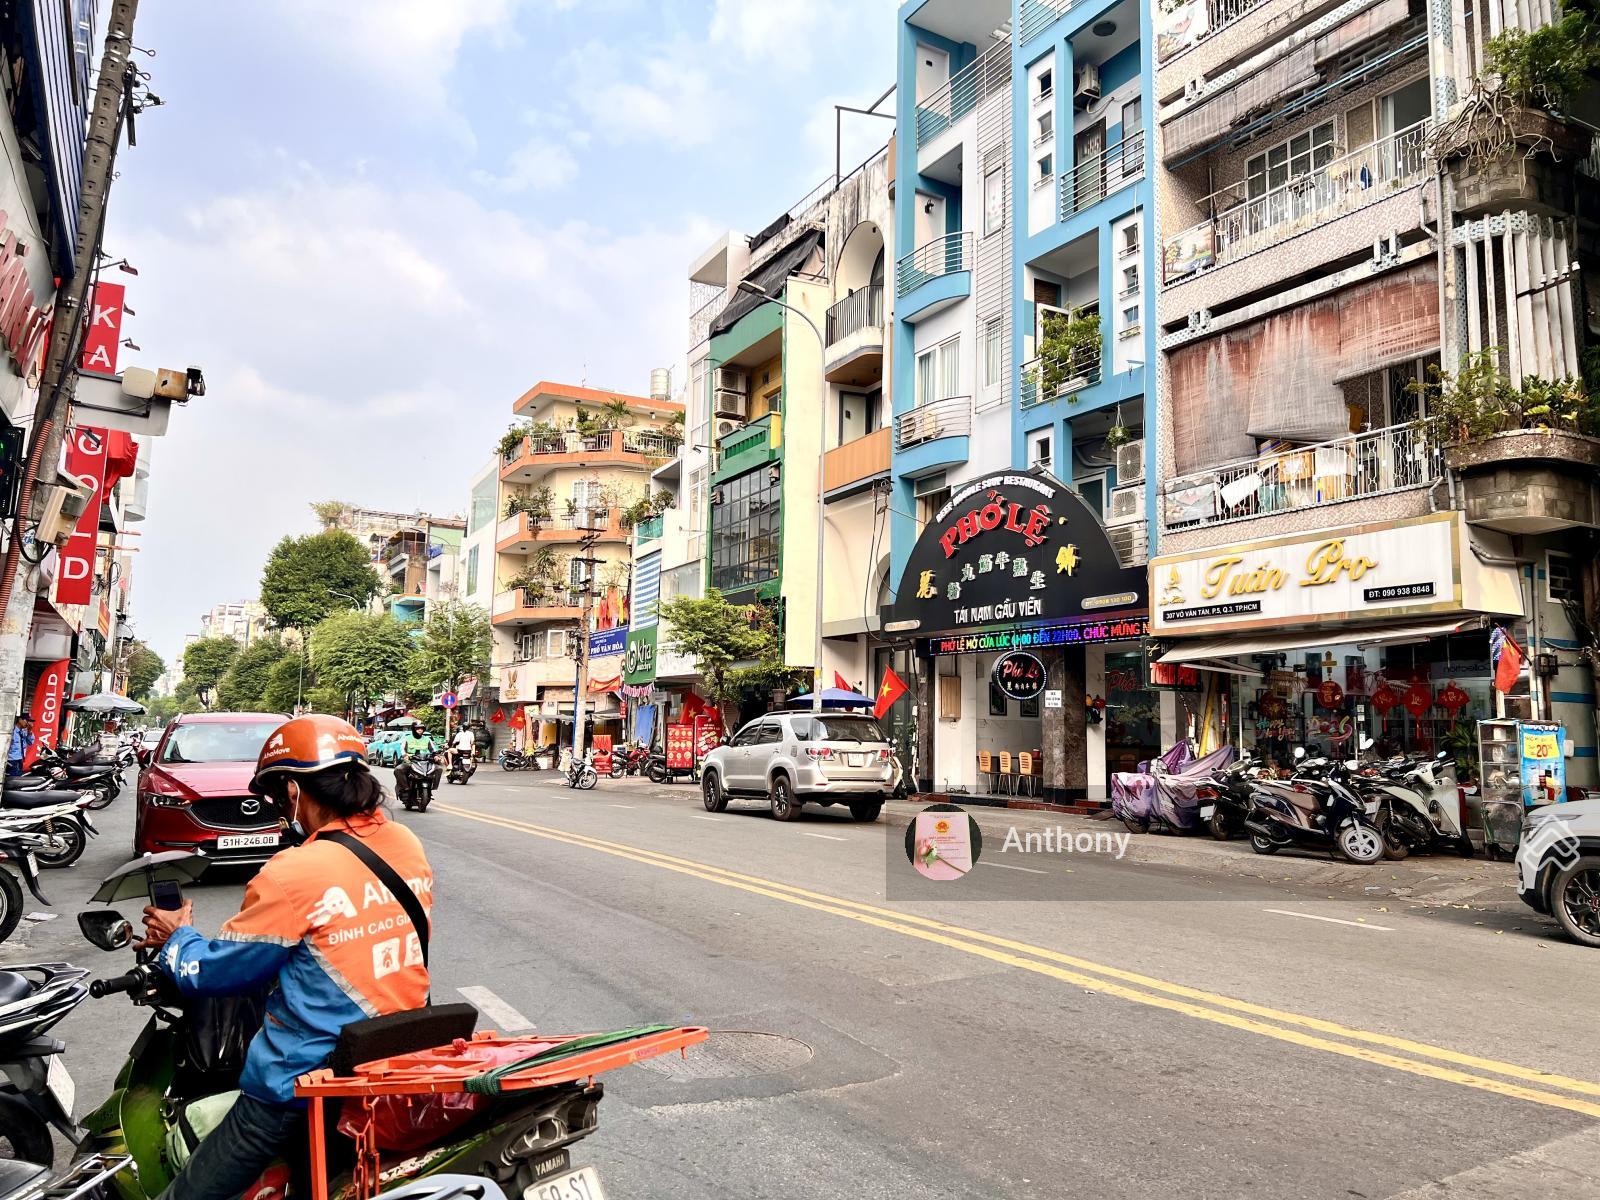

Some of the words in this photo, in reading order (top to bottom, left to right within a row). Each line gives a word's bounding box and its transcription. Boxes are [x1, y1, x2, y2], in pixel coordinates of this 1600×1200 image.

[1004, 475, 1056, 499] RESTAURANT
[939, 489, 1007, 559] PHỞ
[1004, 503, 1052, 548] LỆ
[1201, 557, 1288, 599] Tuấn
[1298, 539, 1379, 586] Pro
[1382, 588, 1396, 597] 090
[1397, 587, 1411, 595] 938
[1412, 585, 1430, 594] 8848
[954, 605, 969, 624] TÁI
[971, 604, 992, 624] NẠM
[995, 598, 1016, 619] GẦU
[1018, 596, 1042, 617] VIÊN
[1235, 603, 1258, 612] TP.HCM
[941, 639, 956, 652] PHỞ
[957, 636, 965, 652] LỆ
[966, 636, 978, 650] MỞ
[979, 634, 995, 649] CỬA
[996, 631, 1011, 647] LÚC
[1083, 623, 1109, 639] CHÚC
[1111, 619, 1141, 637] MỪNG
[42, 673, 58, 724] GOLD
[264, 747, 291, 760] AhaMove
[223, 836, 274, 847] 51H-246.08
[368, 918, 394, 935] CAO
[535, 1153, 566, 1176] YAMAHA
